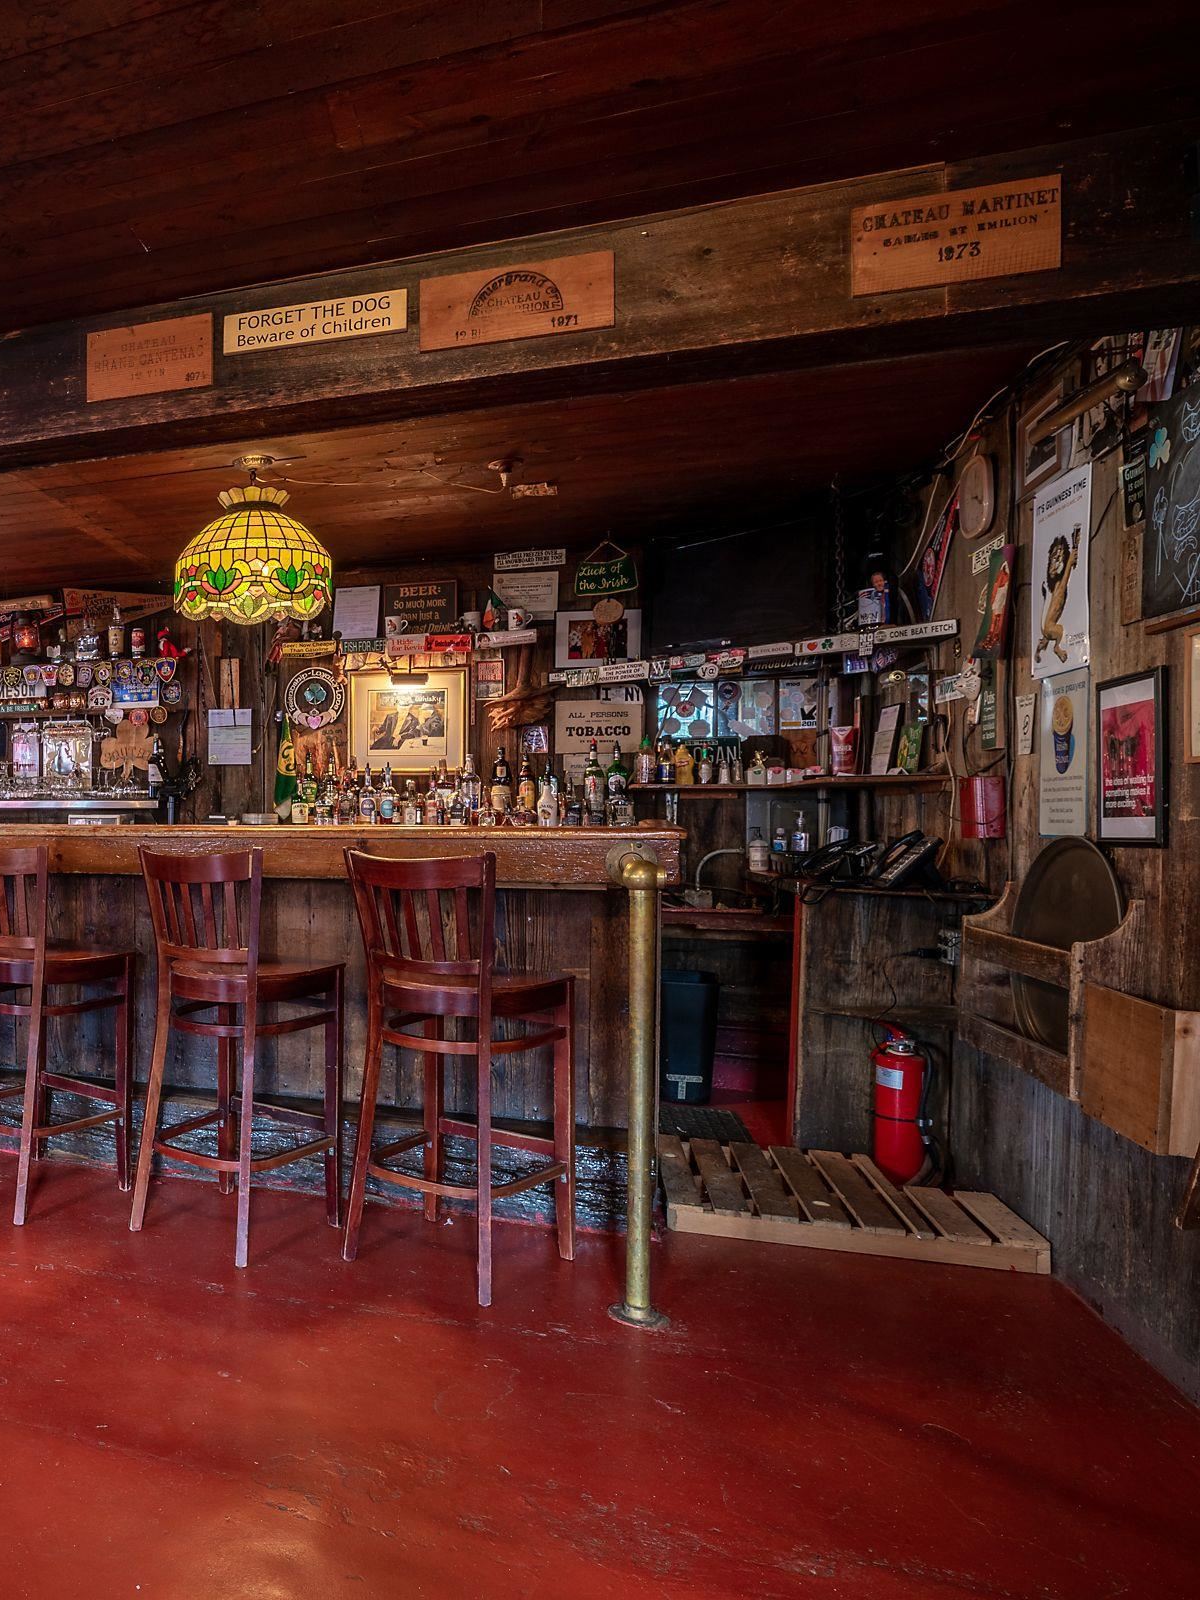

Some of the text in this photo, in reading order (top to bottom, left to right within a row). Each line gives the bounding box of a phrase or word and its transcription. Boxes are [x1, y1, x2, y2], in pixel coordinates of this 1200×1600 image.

[862, 188, 1060, 232] CHATEAU MARTINET
[977, 214, 1039, 232] EMILION
[487, 291, 541, 308] CHATEAU
[237, 296, 391, 332] FORGET THE DOG
[237, 315, 392, 348] Beware of Children
[1045, 487, 1072, 511] GUINNESS
[1072, 477, 1087, 494] TIME
[579, 563, 621, 576] Luck of
[579, 577, 629, 591] the Irish
[400, 585, 442, 598] BEER:
[889, 624, 955, 640] CONE BEAT FETCH
[344, 640, 358, 652] FISH
[359, 640, 370, 651] FOR
[602, 663, 626, 671] IRISHMEN
[599, 674, 620, 682] POSITIVE
[620, 672, 645, 681] DRINKING
[625, 687, 640, 701] NY
[93, 696, 106, 706] 43
[565, 726, 631, 738] TOBACCO
[693, 744, 738, 764] OGAN
[1104, 778, 1113, 787] the
[1113, 776, 1124, 786] idea
[1129, 774, 1147, 786] waiting
[1104, 787, 1130, 799] something
[1130, 786, 1147, 796] makes
[1104, 800, 1117, 809] more
